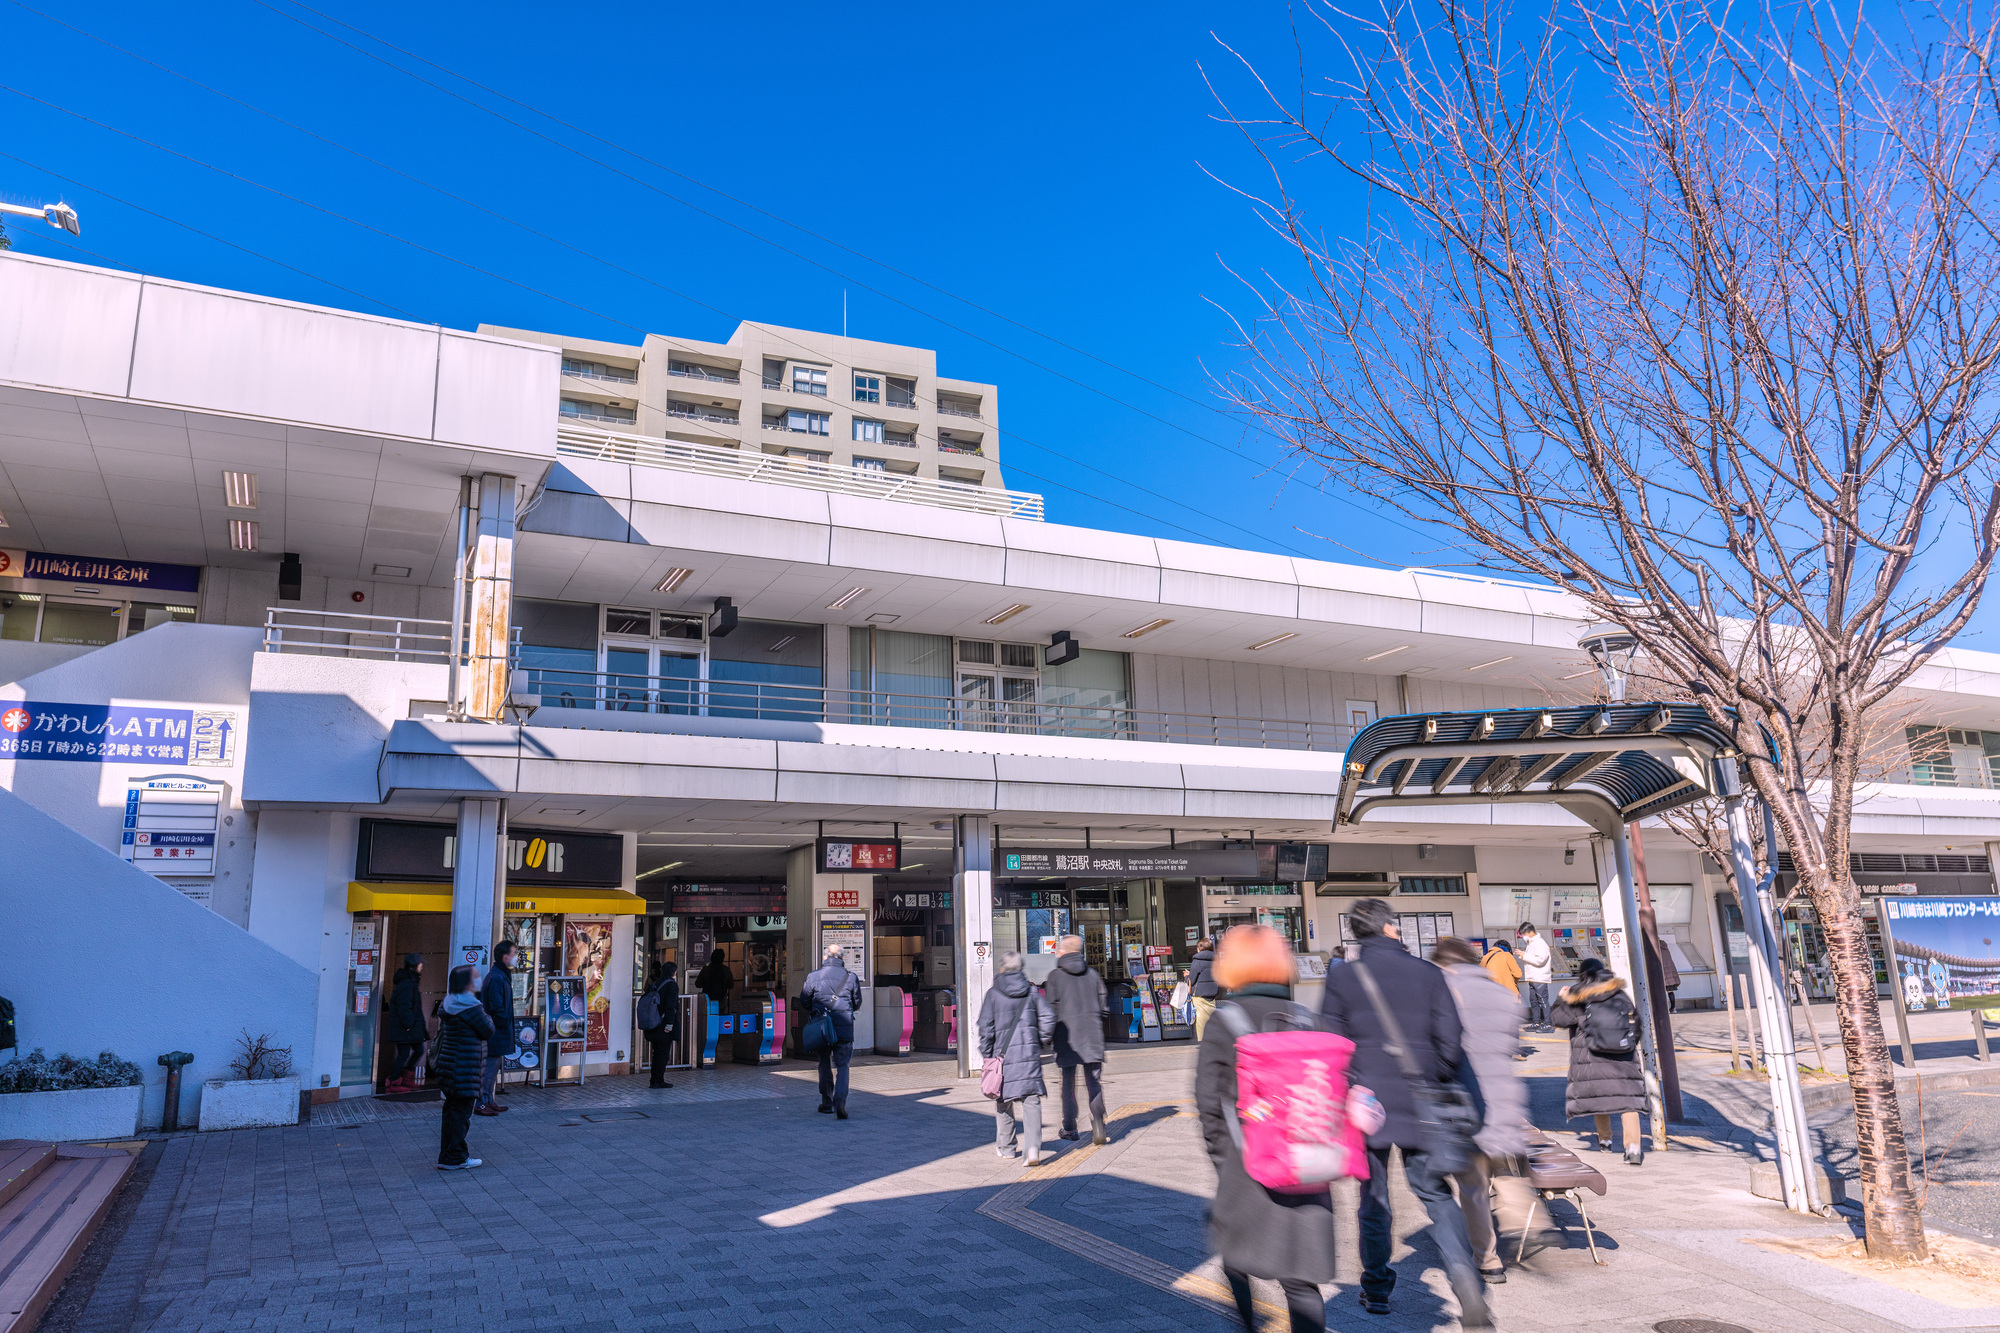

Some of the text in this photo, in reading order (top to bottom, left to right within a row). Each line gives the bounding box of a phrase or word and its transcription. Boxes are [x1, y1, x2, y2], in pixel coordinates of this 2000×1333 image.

[27, 557, 150, 583] 川崎信用金庫
[160, 835, 205, 843] 川崎信用金庫
[153, 848, 195, 857] 営業中
[1020, 854, 1049, 862] 田園都市線
[1056, 855, 1124, 871] 鷺沼駅 中央改札
[1900, 901, 2000, 918] 川崎市は川崎フロンターレを
